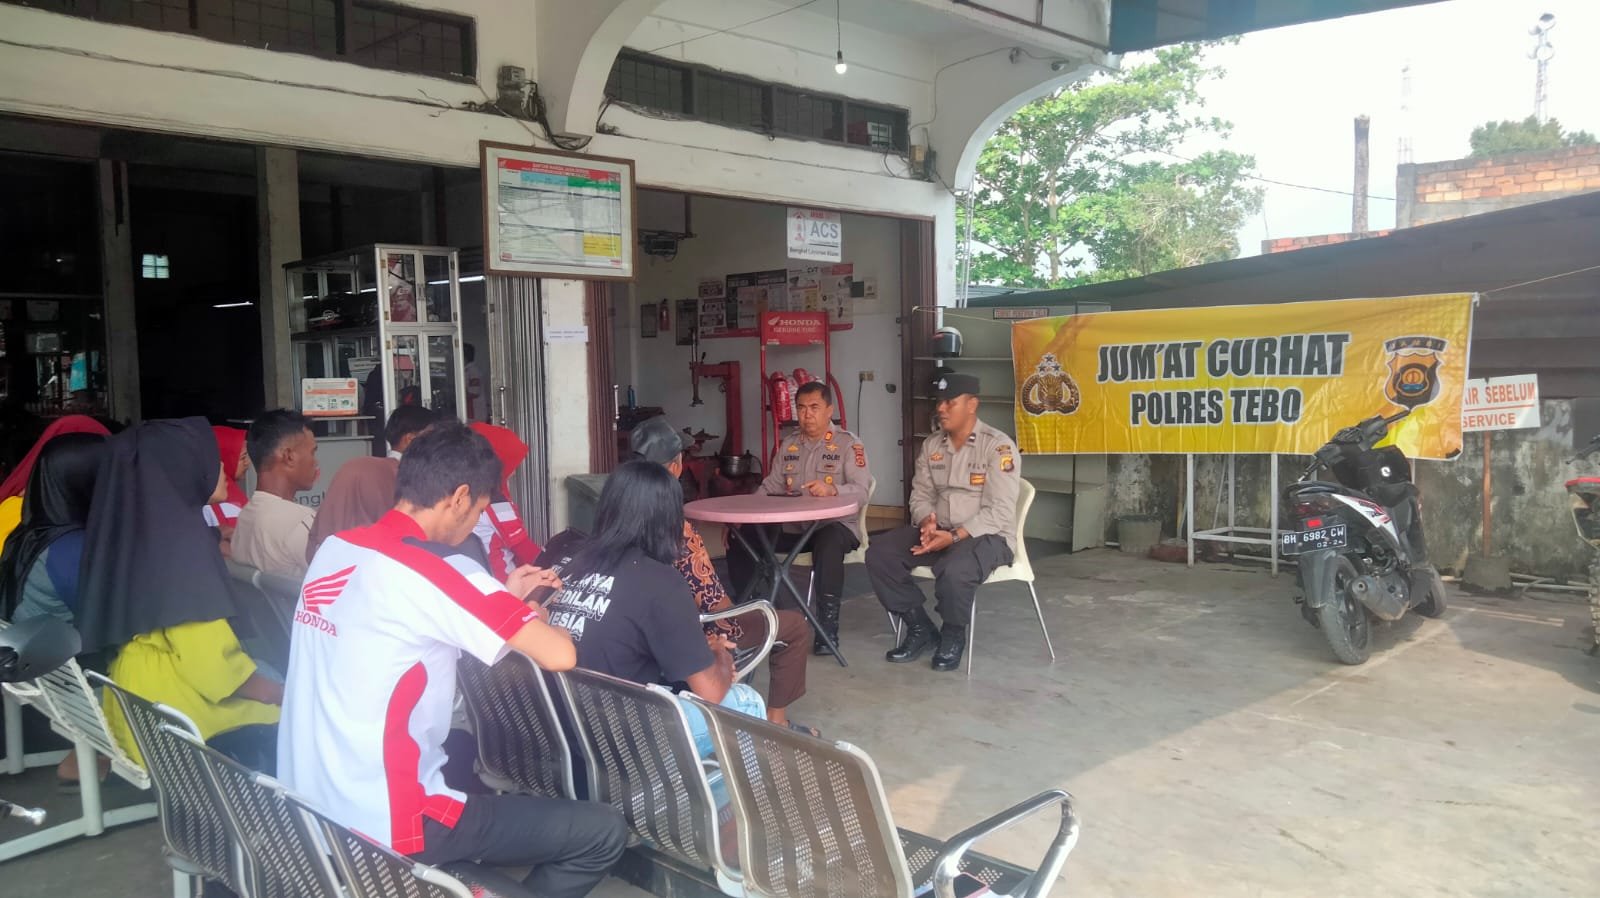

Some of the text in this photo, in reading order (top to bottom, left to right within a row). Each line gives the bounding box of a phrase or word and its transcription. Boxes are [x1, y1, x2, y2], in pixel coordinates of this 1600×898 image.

[810, 221, 838, 238] ACS
[1097, 333, 1350, 382] JUM'AT CURHAT
[1485, 381, 1535, 404] SEBELUM
[1131, 387, 1302, 425] POLRES TEBO
[1463, 412, 1516, 428] SERVICE
[1283, 526, 1344, 545] BH 6982 CW
[295, 610, 338, 637] HONDA
